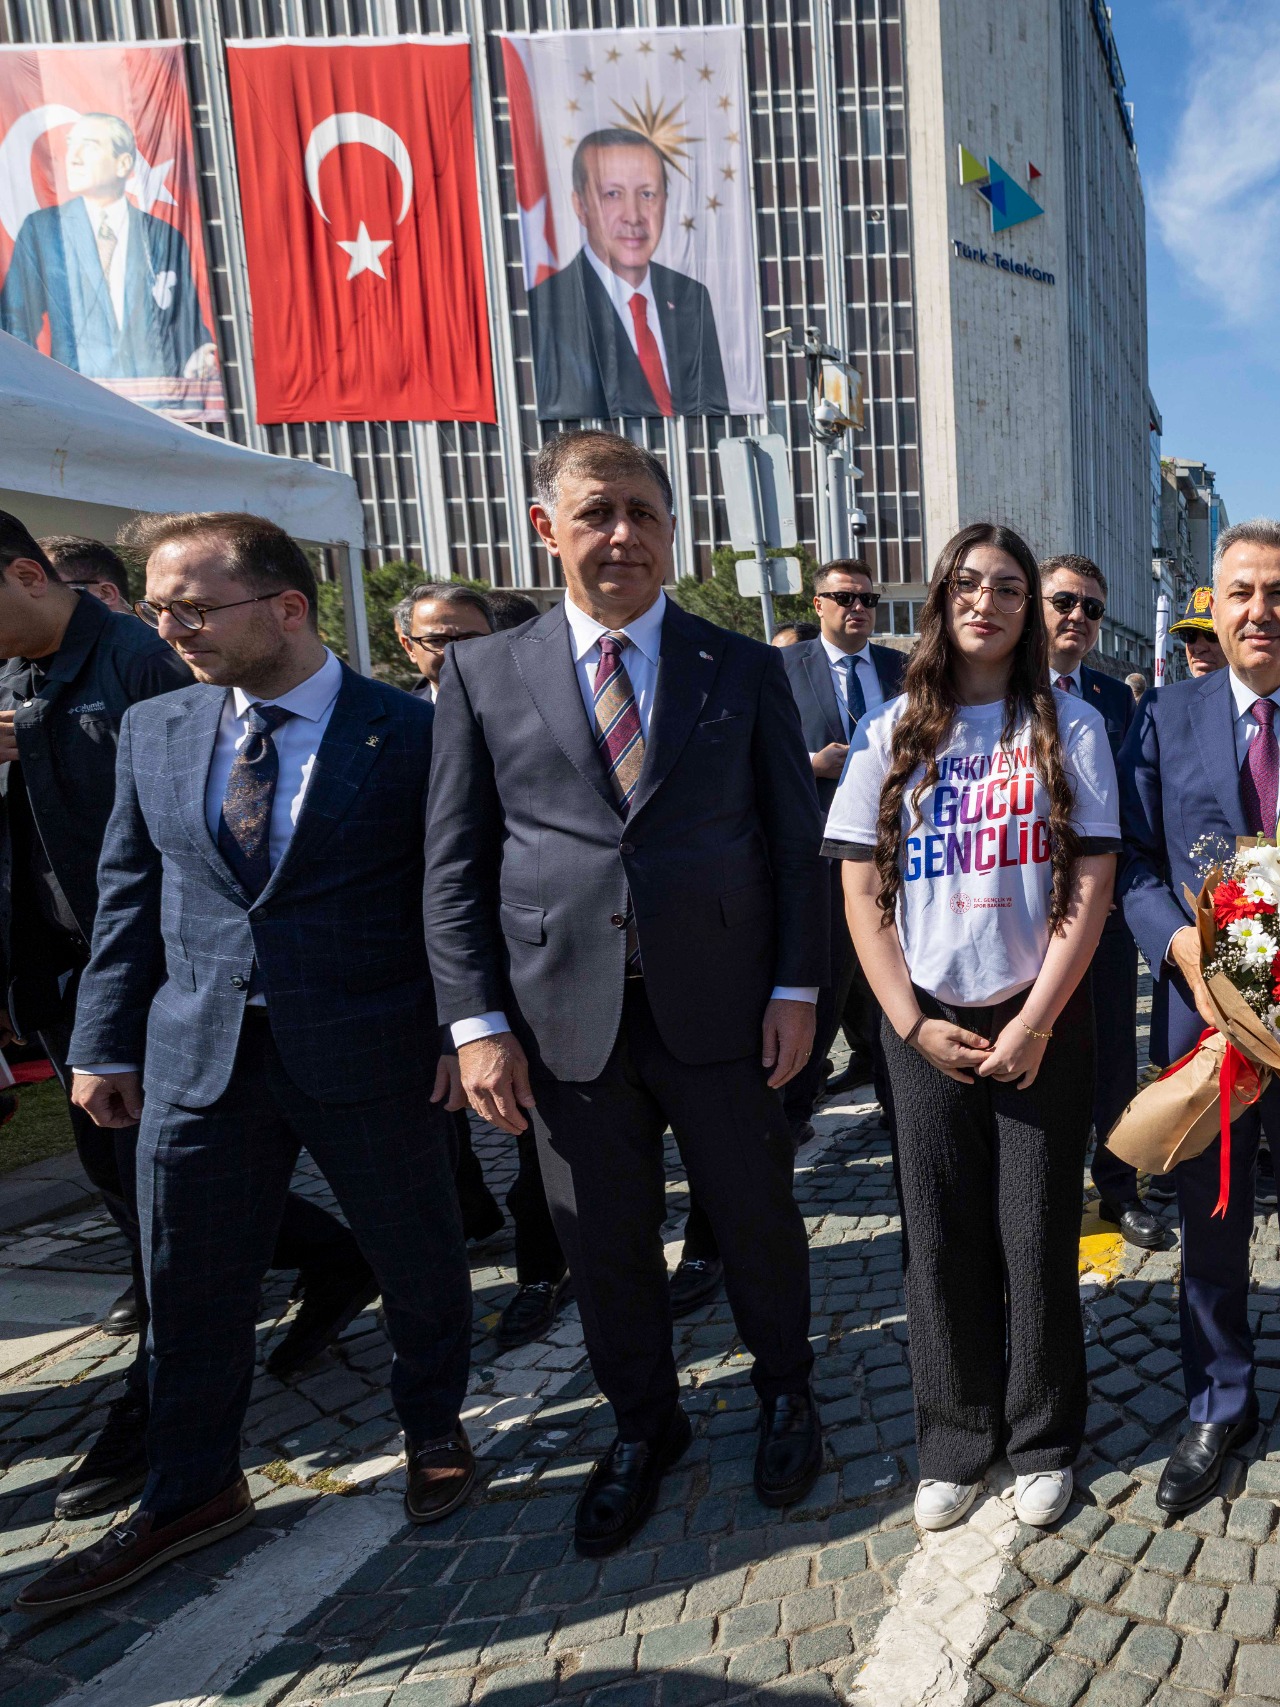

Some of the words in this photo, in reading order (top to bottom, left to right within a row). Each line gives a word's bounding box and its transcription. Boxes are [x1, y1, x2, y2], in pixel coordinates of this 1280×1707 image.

[952, 239, 988, 265] Türk
[993, 252, 1055, 286] Telekom
[933, 773, 1035, 828] GÜCÜ
